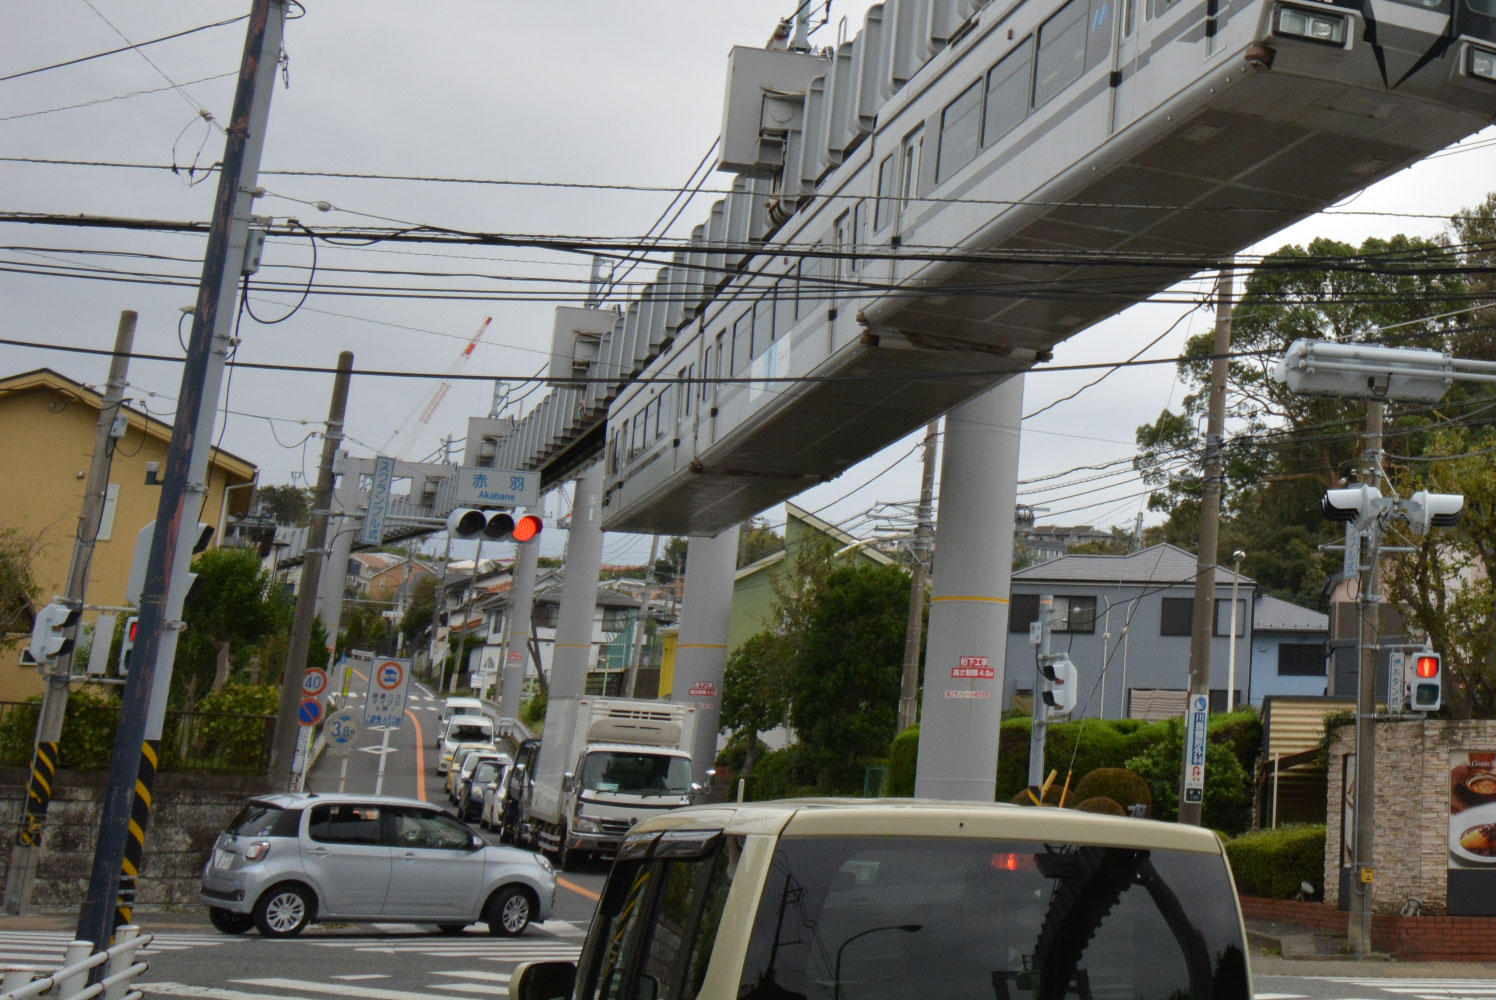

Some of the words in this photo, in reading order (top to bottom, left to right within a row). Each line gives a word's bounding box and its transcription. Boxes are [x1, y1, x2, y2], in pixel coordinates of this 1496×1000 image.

[472, 473, 525, 492] 赤羽
[366, 460, 392, 541] スクランブル式
[478, 490, 515, 502] Akabane
[305, 676, 322, 689] 40
